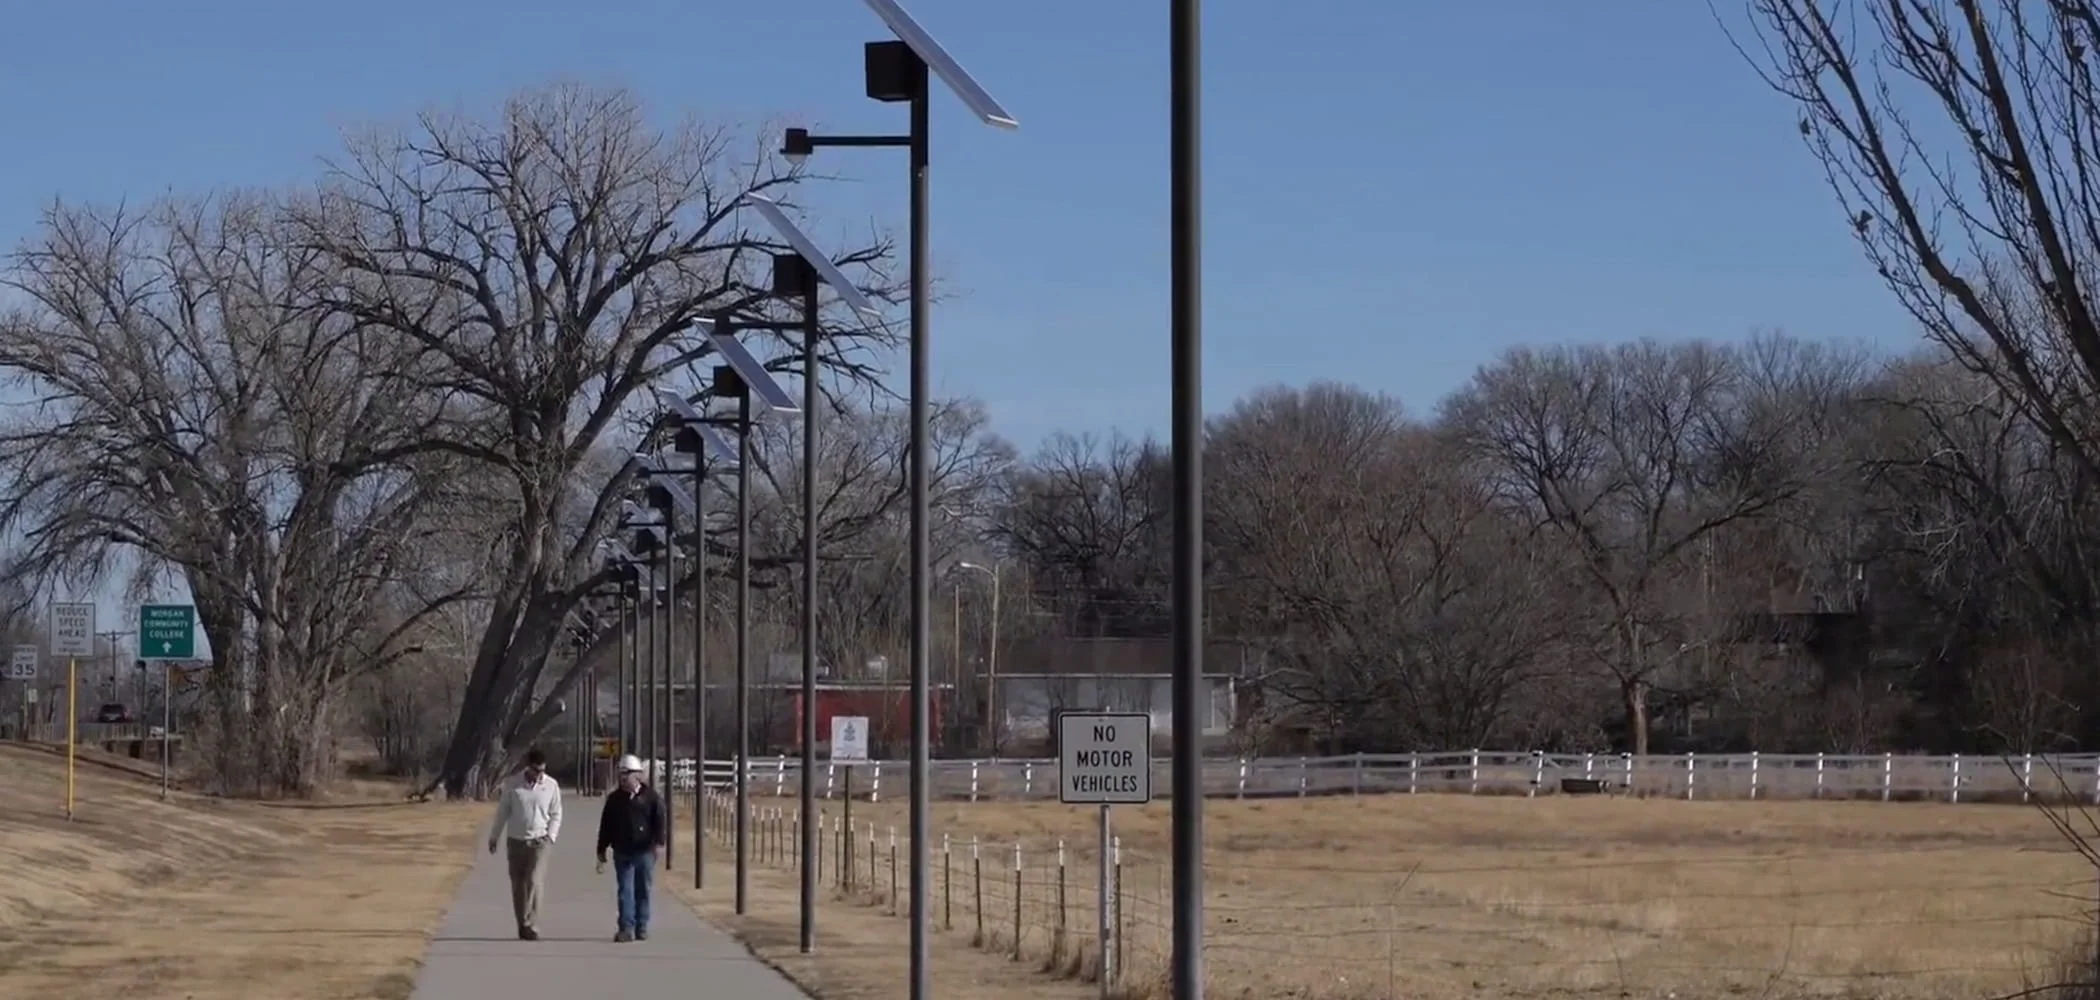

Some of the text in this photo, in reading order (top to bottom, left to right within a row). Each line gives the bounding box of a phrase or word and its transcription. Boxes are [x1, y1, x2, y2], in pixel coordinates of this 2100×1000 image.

[151, 610, 184, 618] MORGAN
[59, 618, 86, 627] SPEED
[144, 620, 189, 628] COMMUNITY
[58, 629, 87, 638] AHEAD
[149, 630, 184, 639] COLLEGE
[15, 663, 35, 676] 35
[1093, 725, 1116, 742] NO
[1077, 750, 1133, 768] MOTOR
[1072, 775, 1138, 792] VEHICLES
